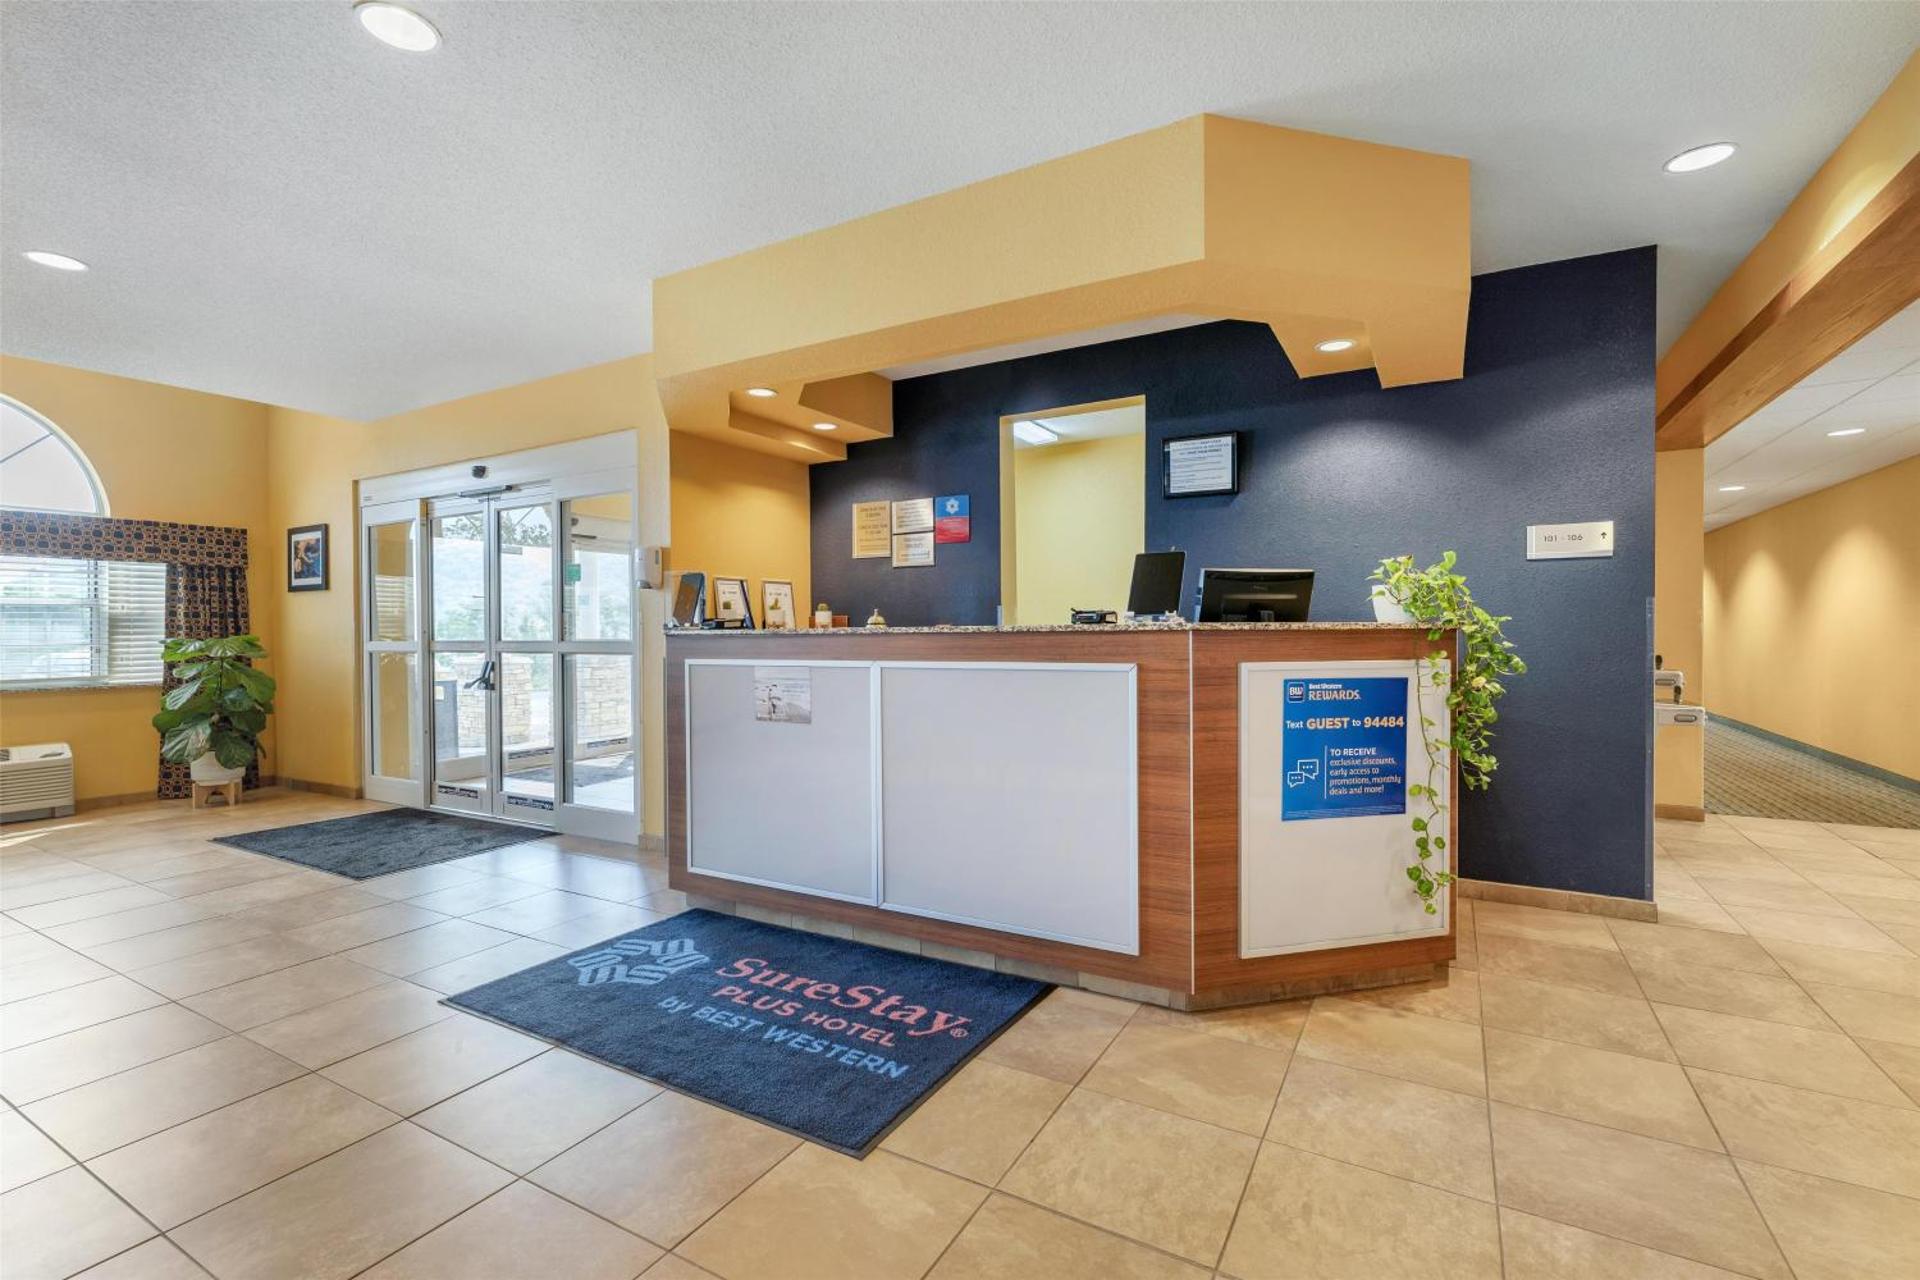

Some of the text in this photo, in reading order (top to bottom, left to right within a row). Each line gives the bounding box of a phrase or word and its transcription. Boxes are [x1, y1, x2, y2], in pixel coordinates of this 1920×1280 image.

[1286, 716, 1404, 729] Text GUEST to 94484
[1343, 747, 1376, 756] RECEIVE
[1362, 757, 1397, 765] discounts,
[1329, 769, 1348, 777] early
[1371, 774, 1401, 784] monthly
[1329, 788, 1348, 796] deals
[1364, 785, 1385, 793] more!
[712, 986, 896, 1047] PLUS HOTEL
[658, 996, 909, 1078] by BEST WESTERN
